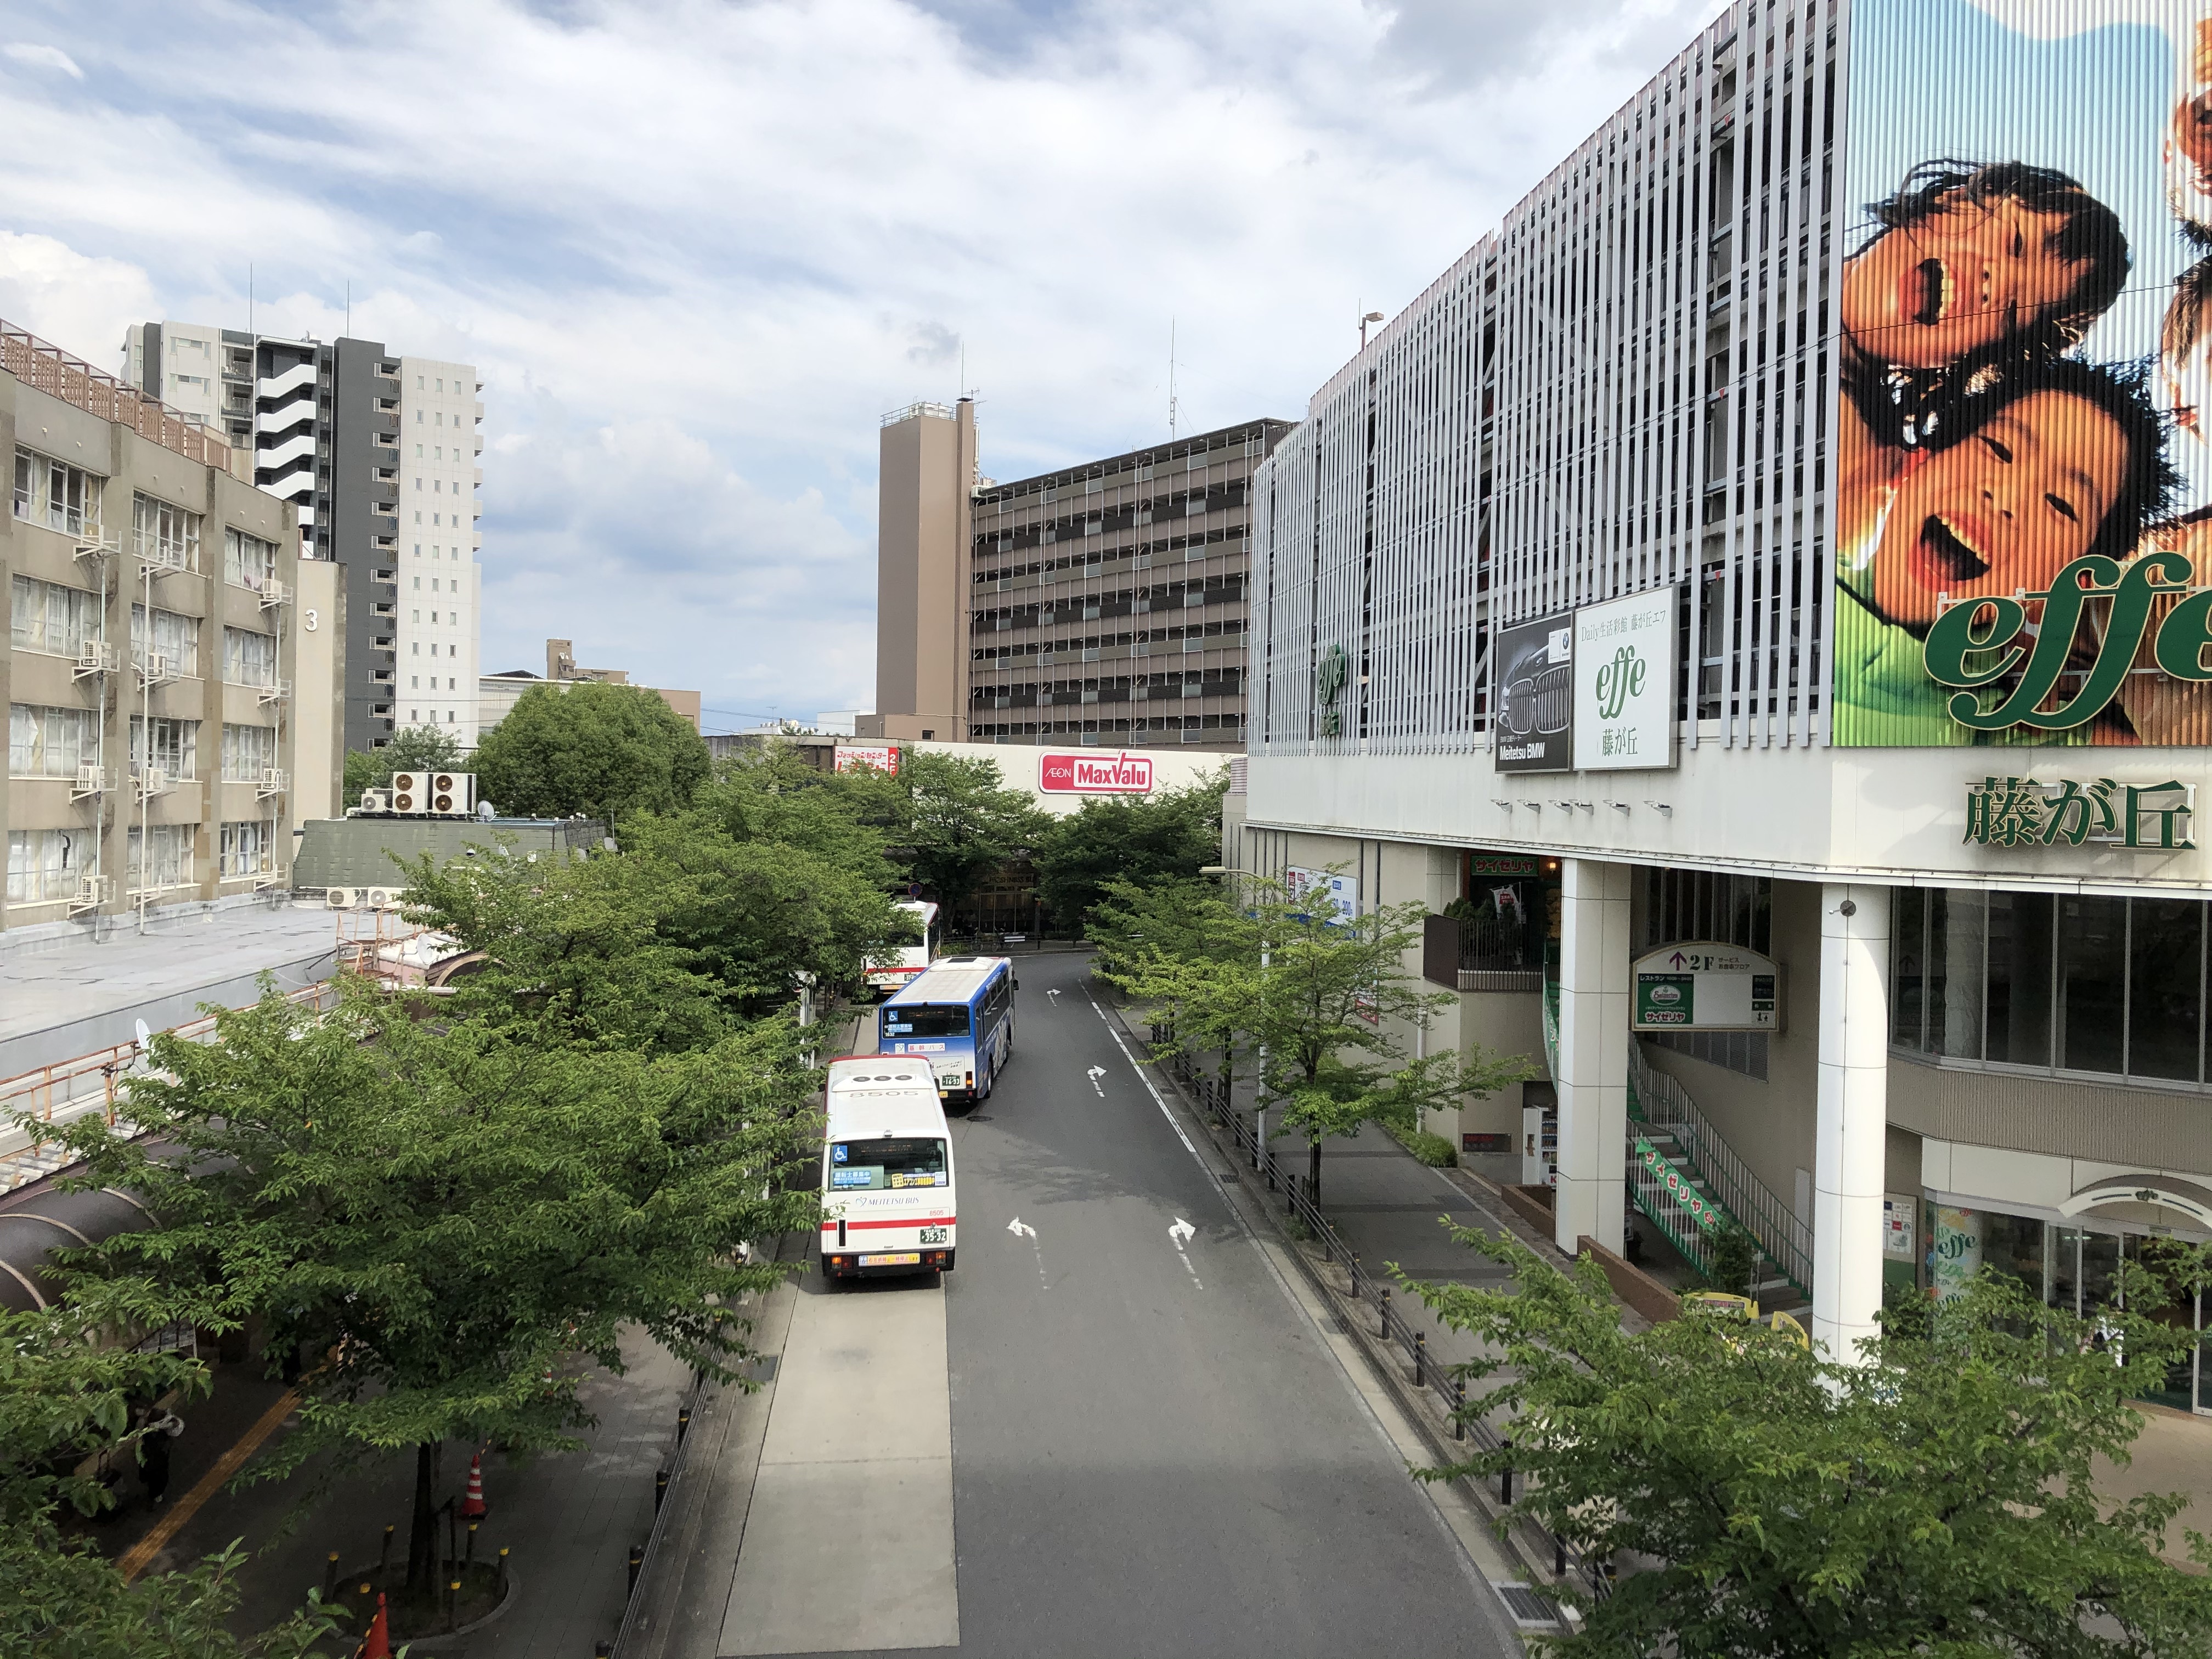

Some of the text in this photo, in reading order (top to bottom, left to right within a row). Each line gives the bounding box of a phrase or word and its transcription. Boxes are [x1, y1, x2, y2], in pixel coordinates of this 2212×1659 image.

[305, 609, 318, 632] 3
[1630, 610, 1666, 631] 藤が丘エフ
[1923, 551, 2212, 731] effe
[1317, 644, 1345, 705] effe
[1596, 645, 1646, 720] effe
[1499, 742, 1545, 760] Meitetsu BMW
[1602, 726, 1638, 757] 藤が丘
[1078, 752, 1146, 785] MaxValu
[1962, 776, 2197, 850] 藤が丘
[1475, 859, 1533, 873] サイゼリヤ
[1690, 955, 1714, 970] 2F
[1645, 1012, 1685, 1022] サイゼリヤ
[1646, 1152, 1702, 1214] サイゼリヤ
[868, 1198, 904, 1206] MEITETSU
[1938, 1233, 1976, 1260] effe
